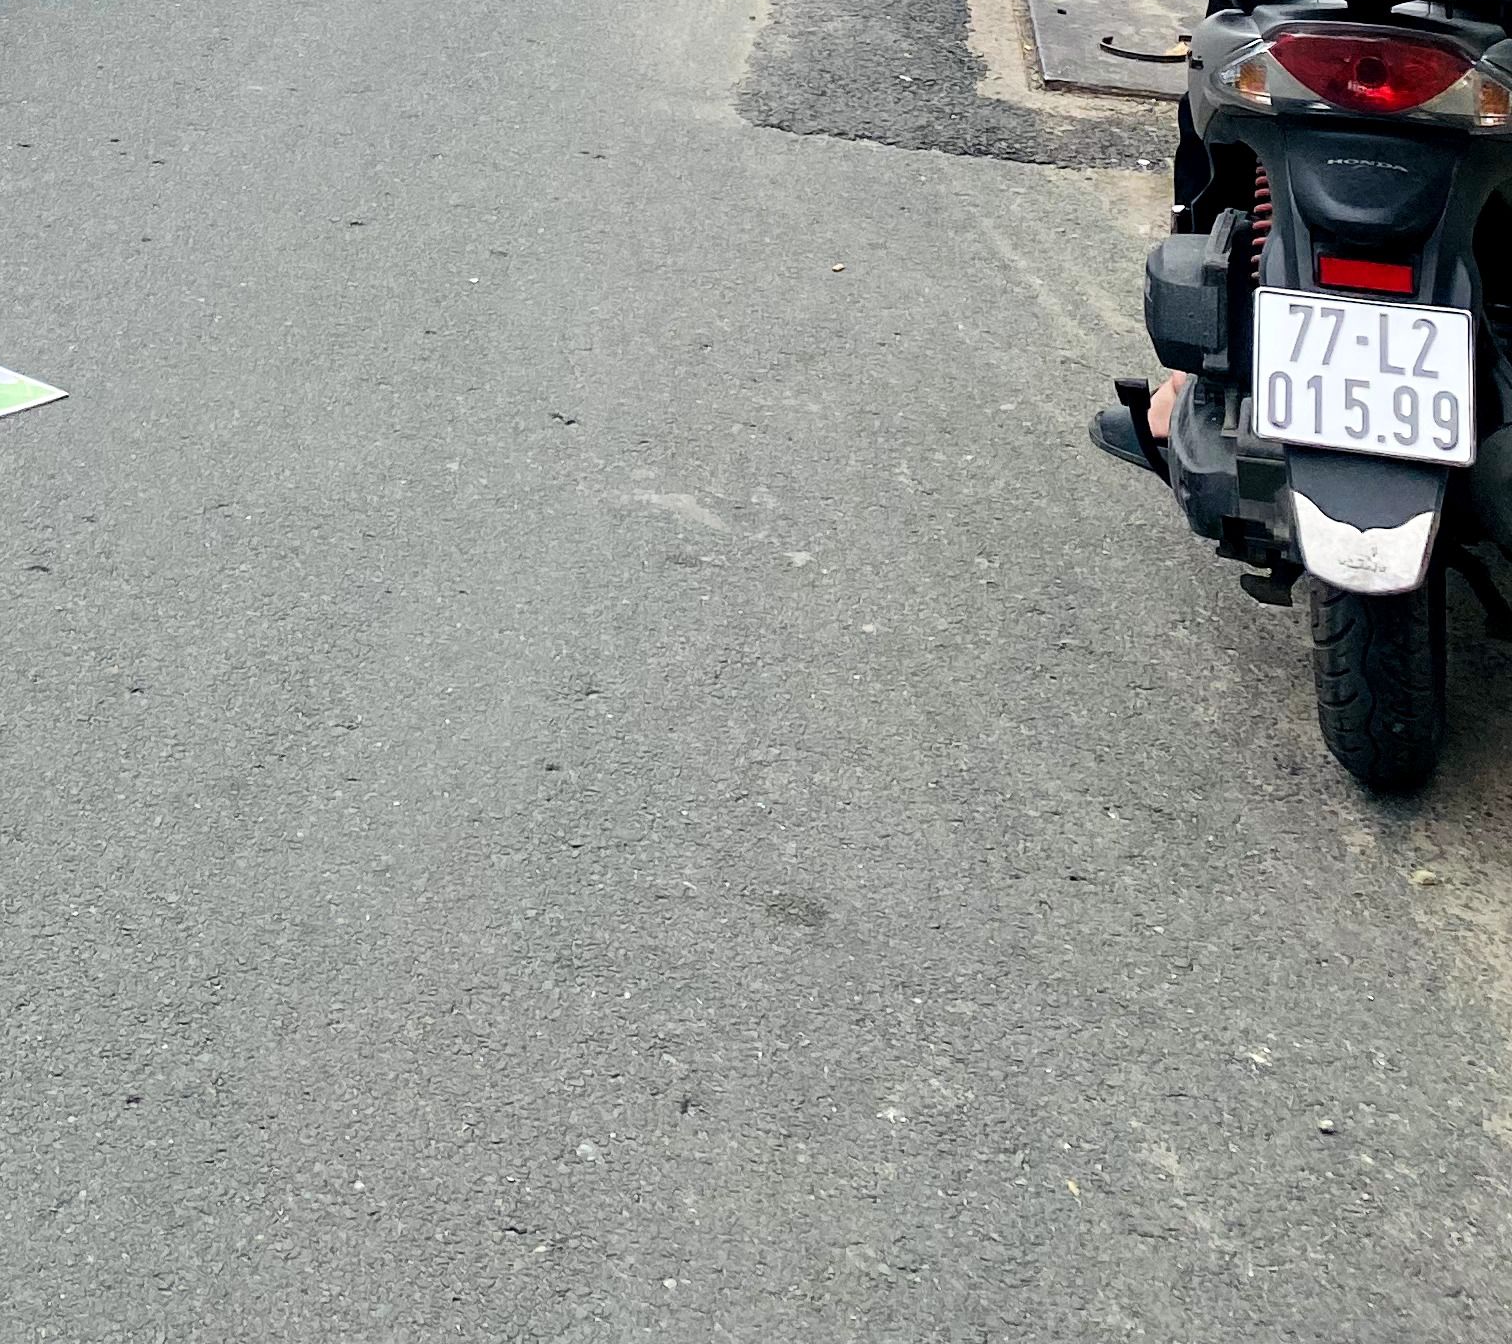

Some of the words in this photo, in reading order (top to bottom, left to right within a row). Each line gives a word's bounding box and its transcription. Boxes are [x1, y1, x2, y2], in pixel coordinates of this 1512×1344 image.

[1326, 156, 1409, 175] HONDA
[1286, 303, 1440, 380] 77-L2
[1266, 369, 1461, 452] 015.99
